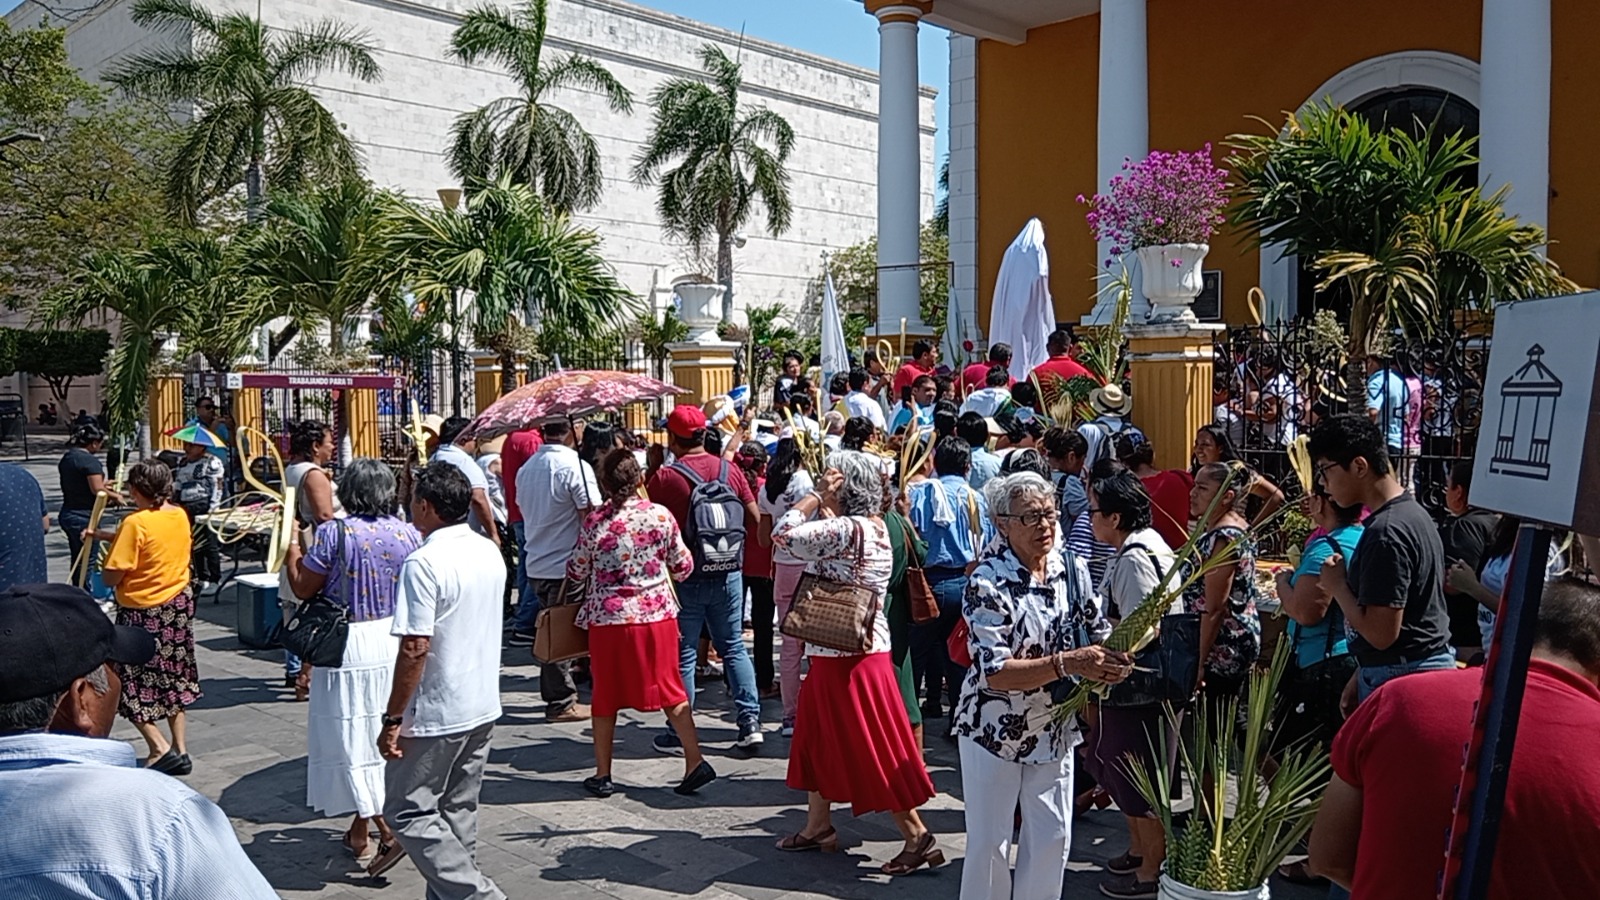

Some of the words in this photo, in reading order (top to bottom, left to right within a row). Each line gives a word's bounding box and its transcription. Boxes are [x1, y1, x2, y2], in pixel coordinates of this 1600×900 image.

[288, 377, 329, 385] TRABAJANDO
[329, 377, 347, 386] PARA
[347, 378, 354, 386] TI
[702, 561, 738, 572] adidas
